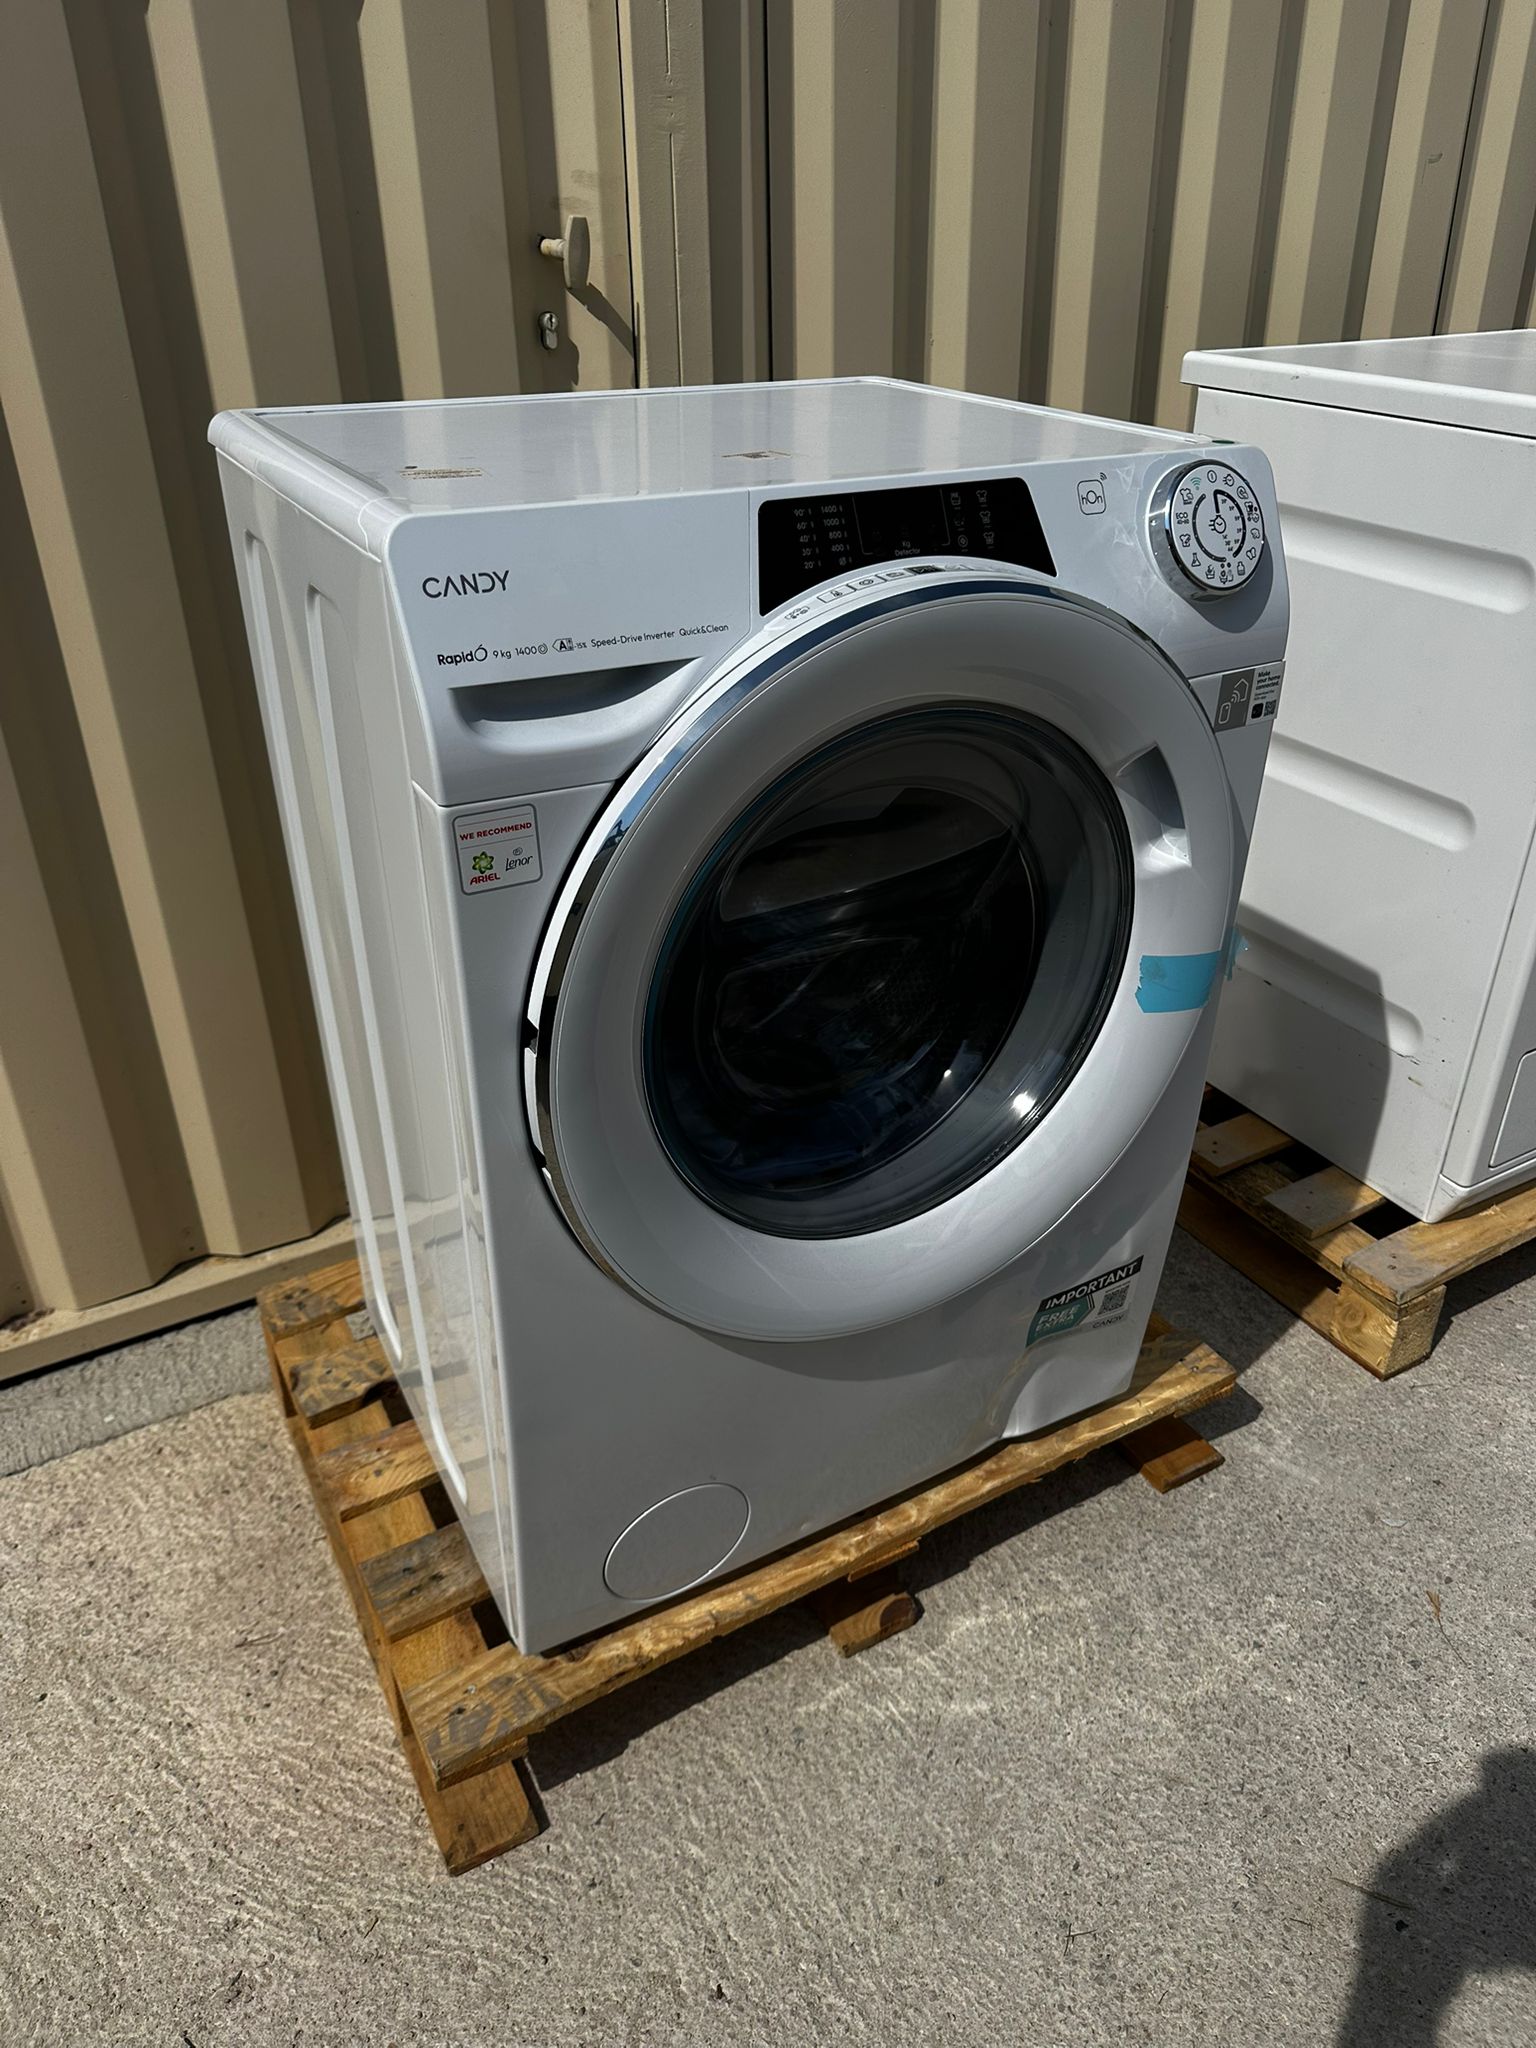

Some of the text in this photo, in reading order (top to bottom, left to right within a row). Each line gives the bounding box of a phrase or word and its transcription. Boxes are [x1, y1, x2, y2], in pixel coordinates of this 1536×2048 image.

[1081, 490, 1103, 505] hOn
[894, 548, 921, 556] Detector
[422, 570, 510, 598] CANDY
[493, 650, 499, 658] 9
[500, 649, 512, 660] kg
[515, 646, 537, 656] 1400
[591, 634, 643, 648] Speed-Drive
[644, 630, 675, 641] Inverter
[679, 624, 729, 637] Quick&Clean
[477, 822, 532, 838] RECOMMEND
[506, 856, 533, 872] Lenor
[470, 872, 501, 886] ARIEL
[1046, 1262, 1137, 1310] IMPORTANT
[1039, 1304, 1080, 1324] FREE
[1093, 1315, 1124, 1329] CANDY
